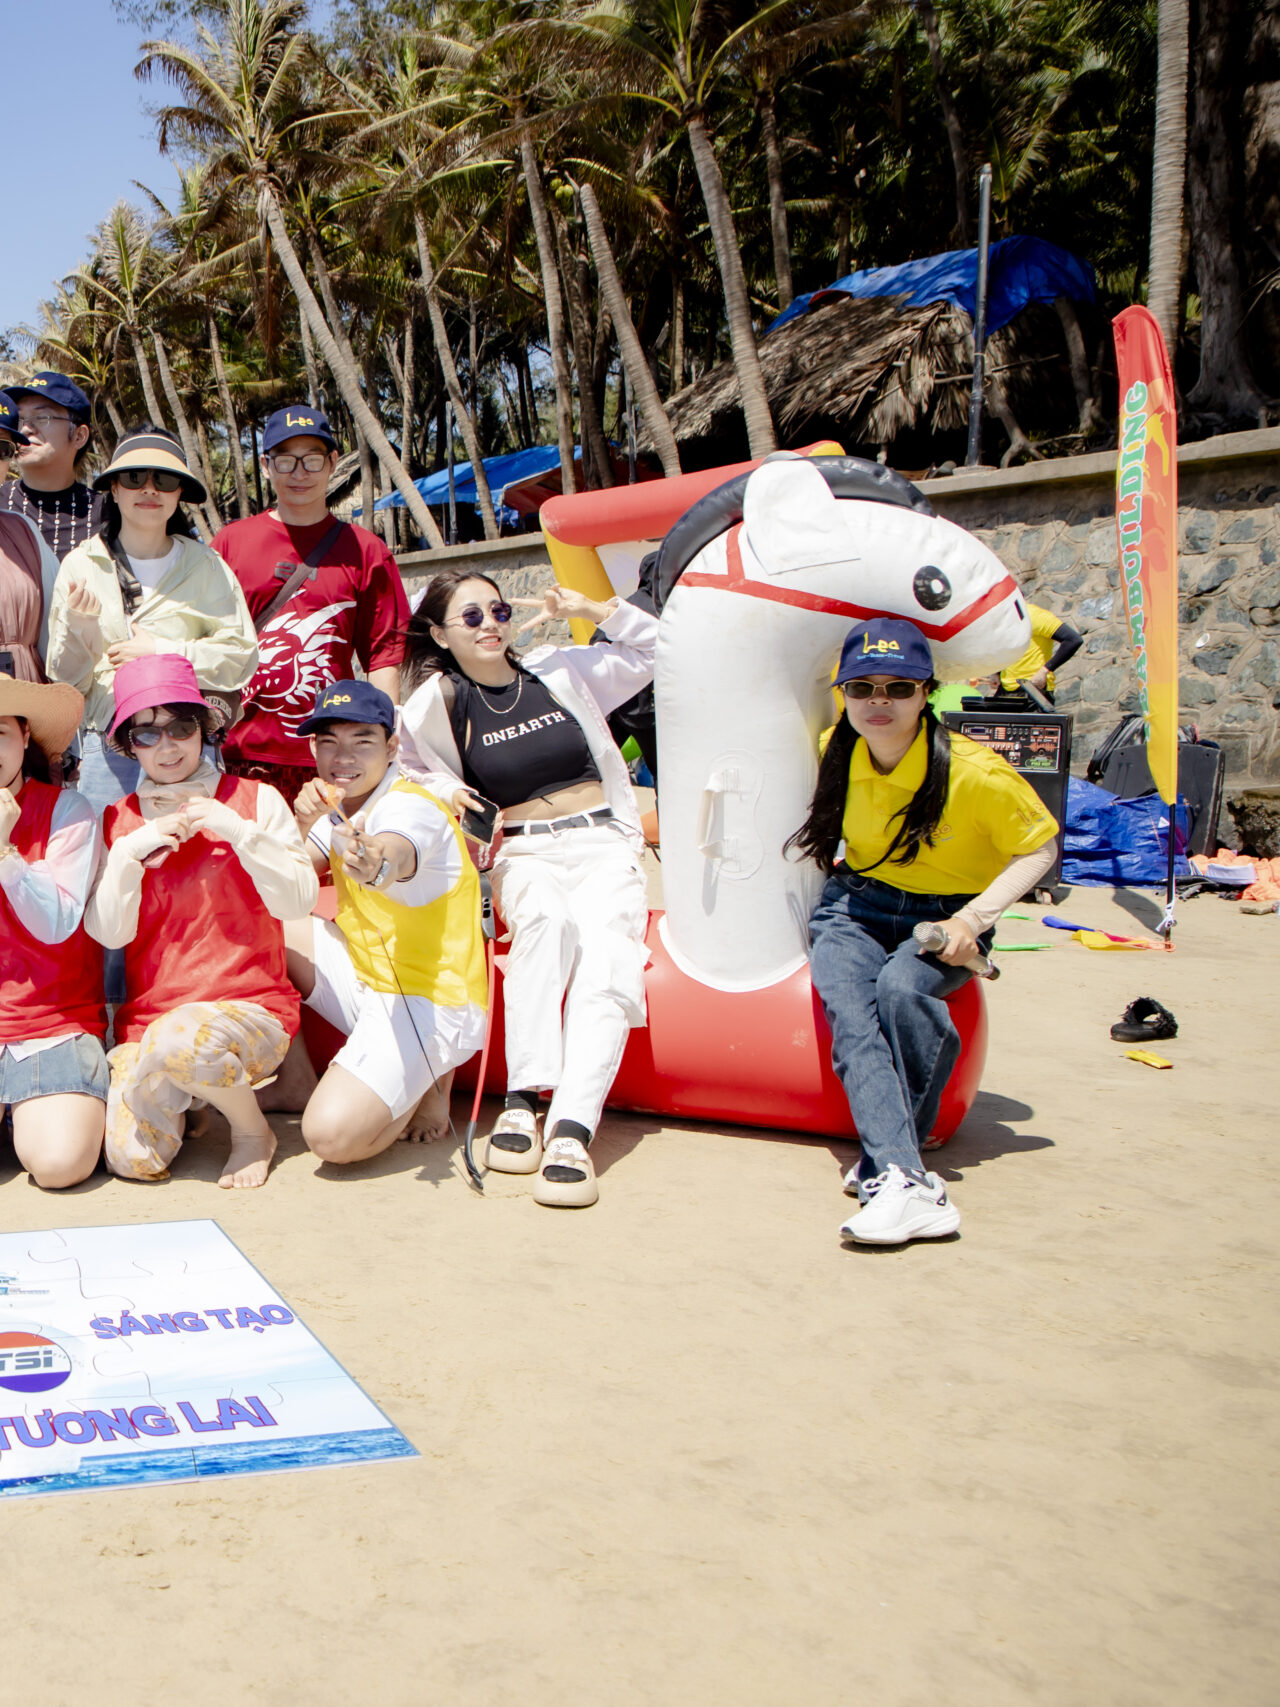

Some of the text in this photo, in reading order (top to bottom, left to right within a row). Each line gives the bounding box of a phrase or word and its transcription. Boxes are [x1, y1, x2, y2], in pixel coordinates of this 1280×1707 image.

[482, 710, 566, 746] ONEARTH
[89, 1304, 295, 1340] SÁNG TẠO
[176, 1396, 279, 1432] LAI
